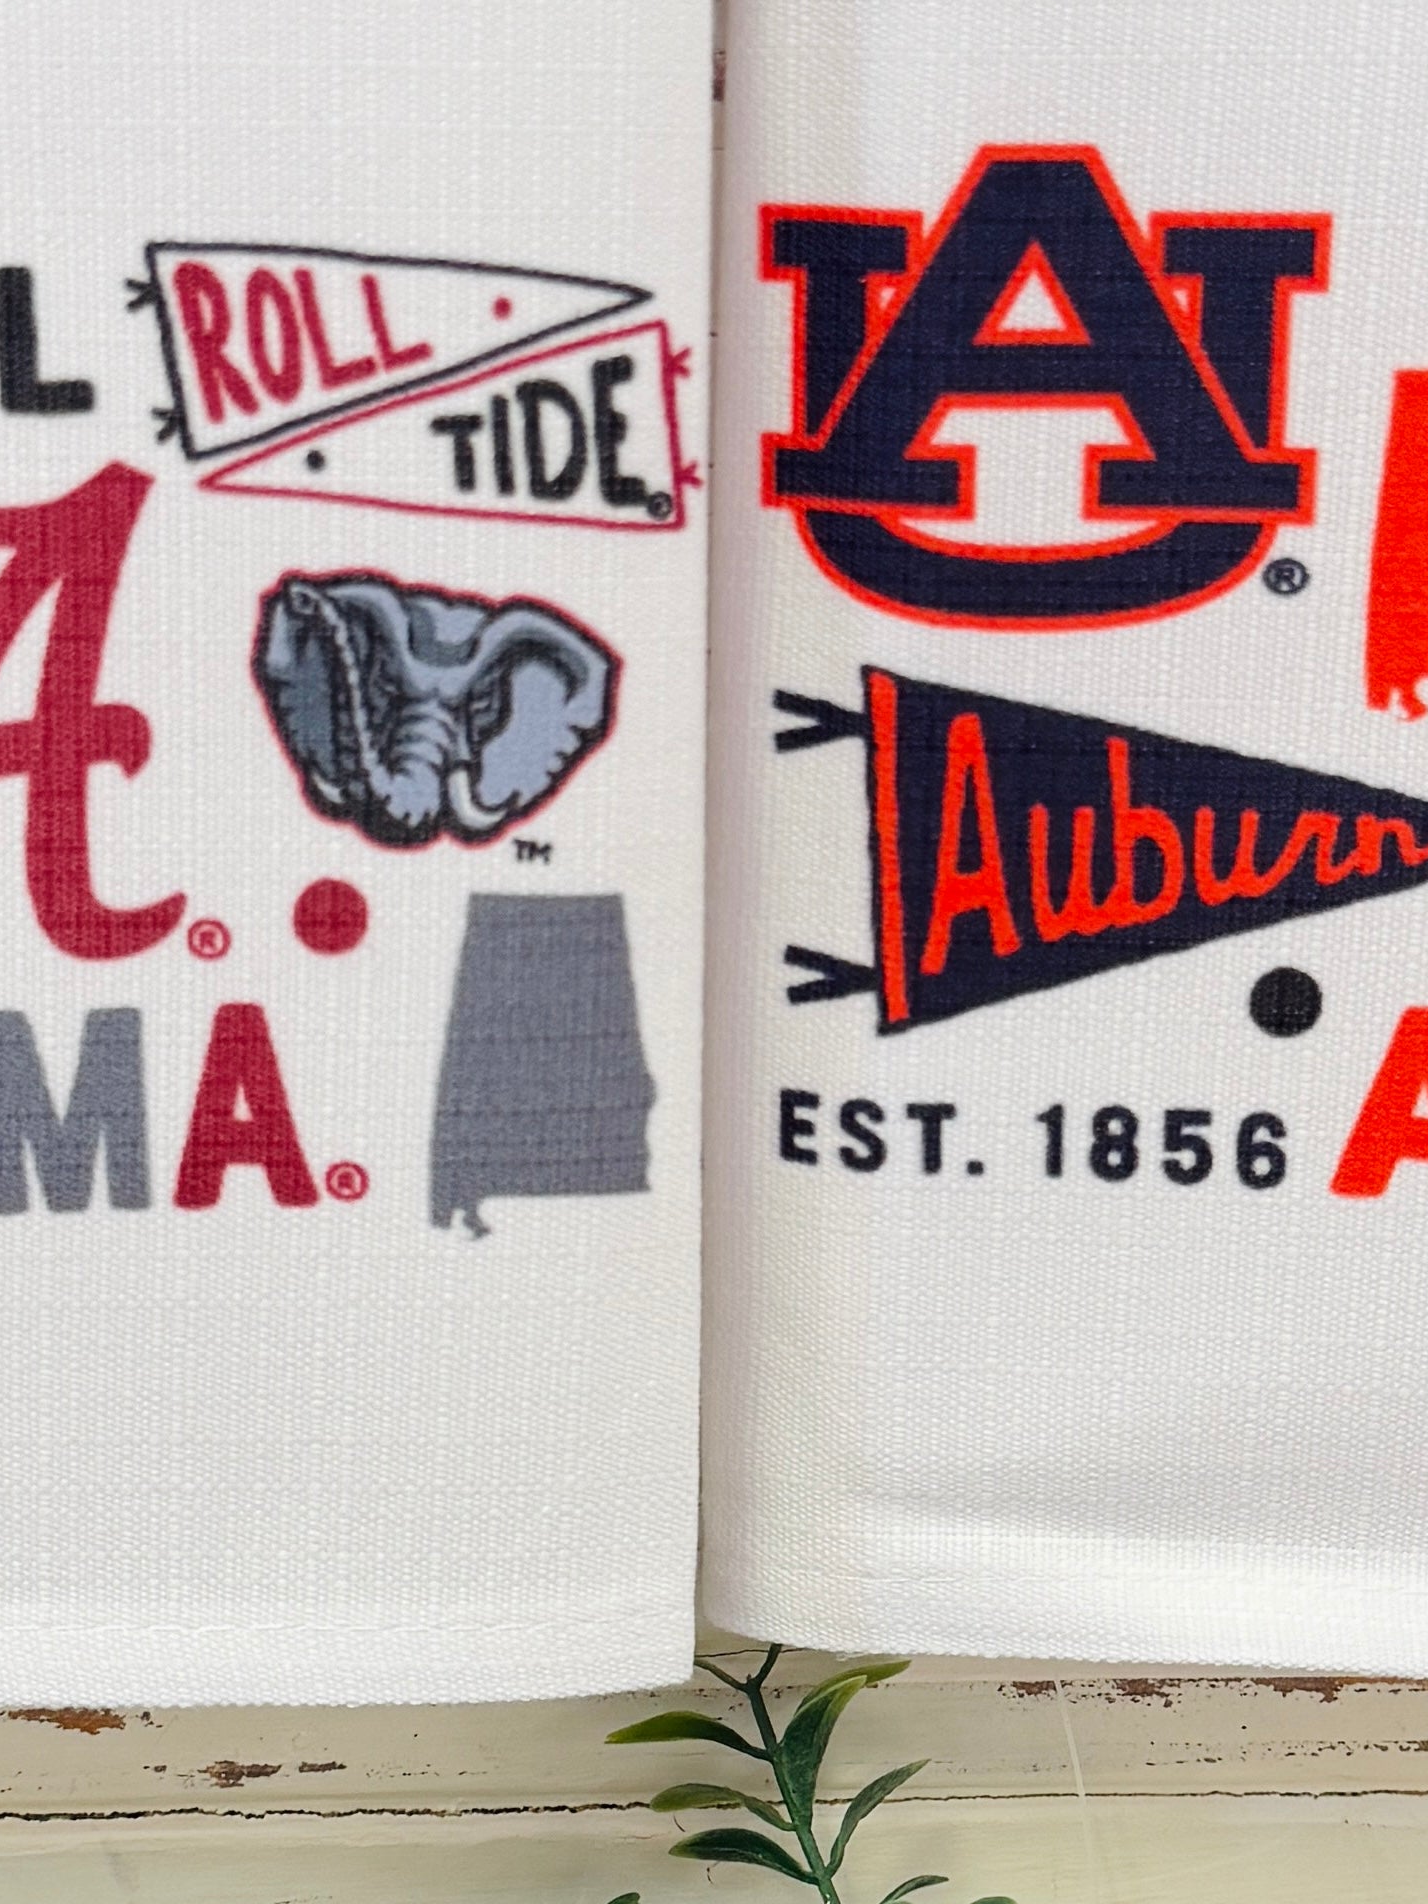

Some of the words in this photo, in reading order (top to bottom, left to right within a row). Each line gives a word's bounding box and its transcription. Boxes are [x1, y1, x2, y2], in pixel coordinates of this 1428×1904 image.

[173, 260, 433, 424] ROLL
[430, 354, 648, 507] TIDE
[779, 1089, 985, 1178] EST.
[1037, 1104, 1289, 1192] 1856
